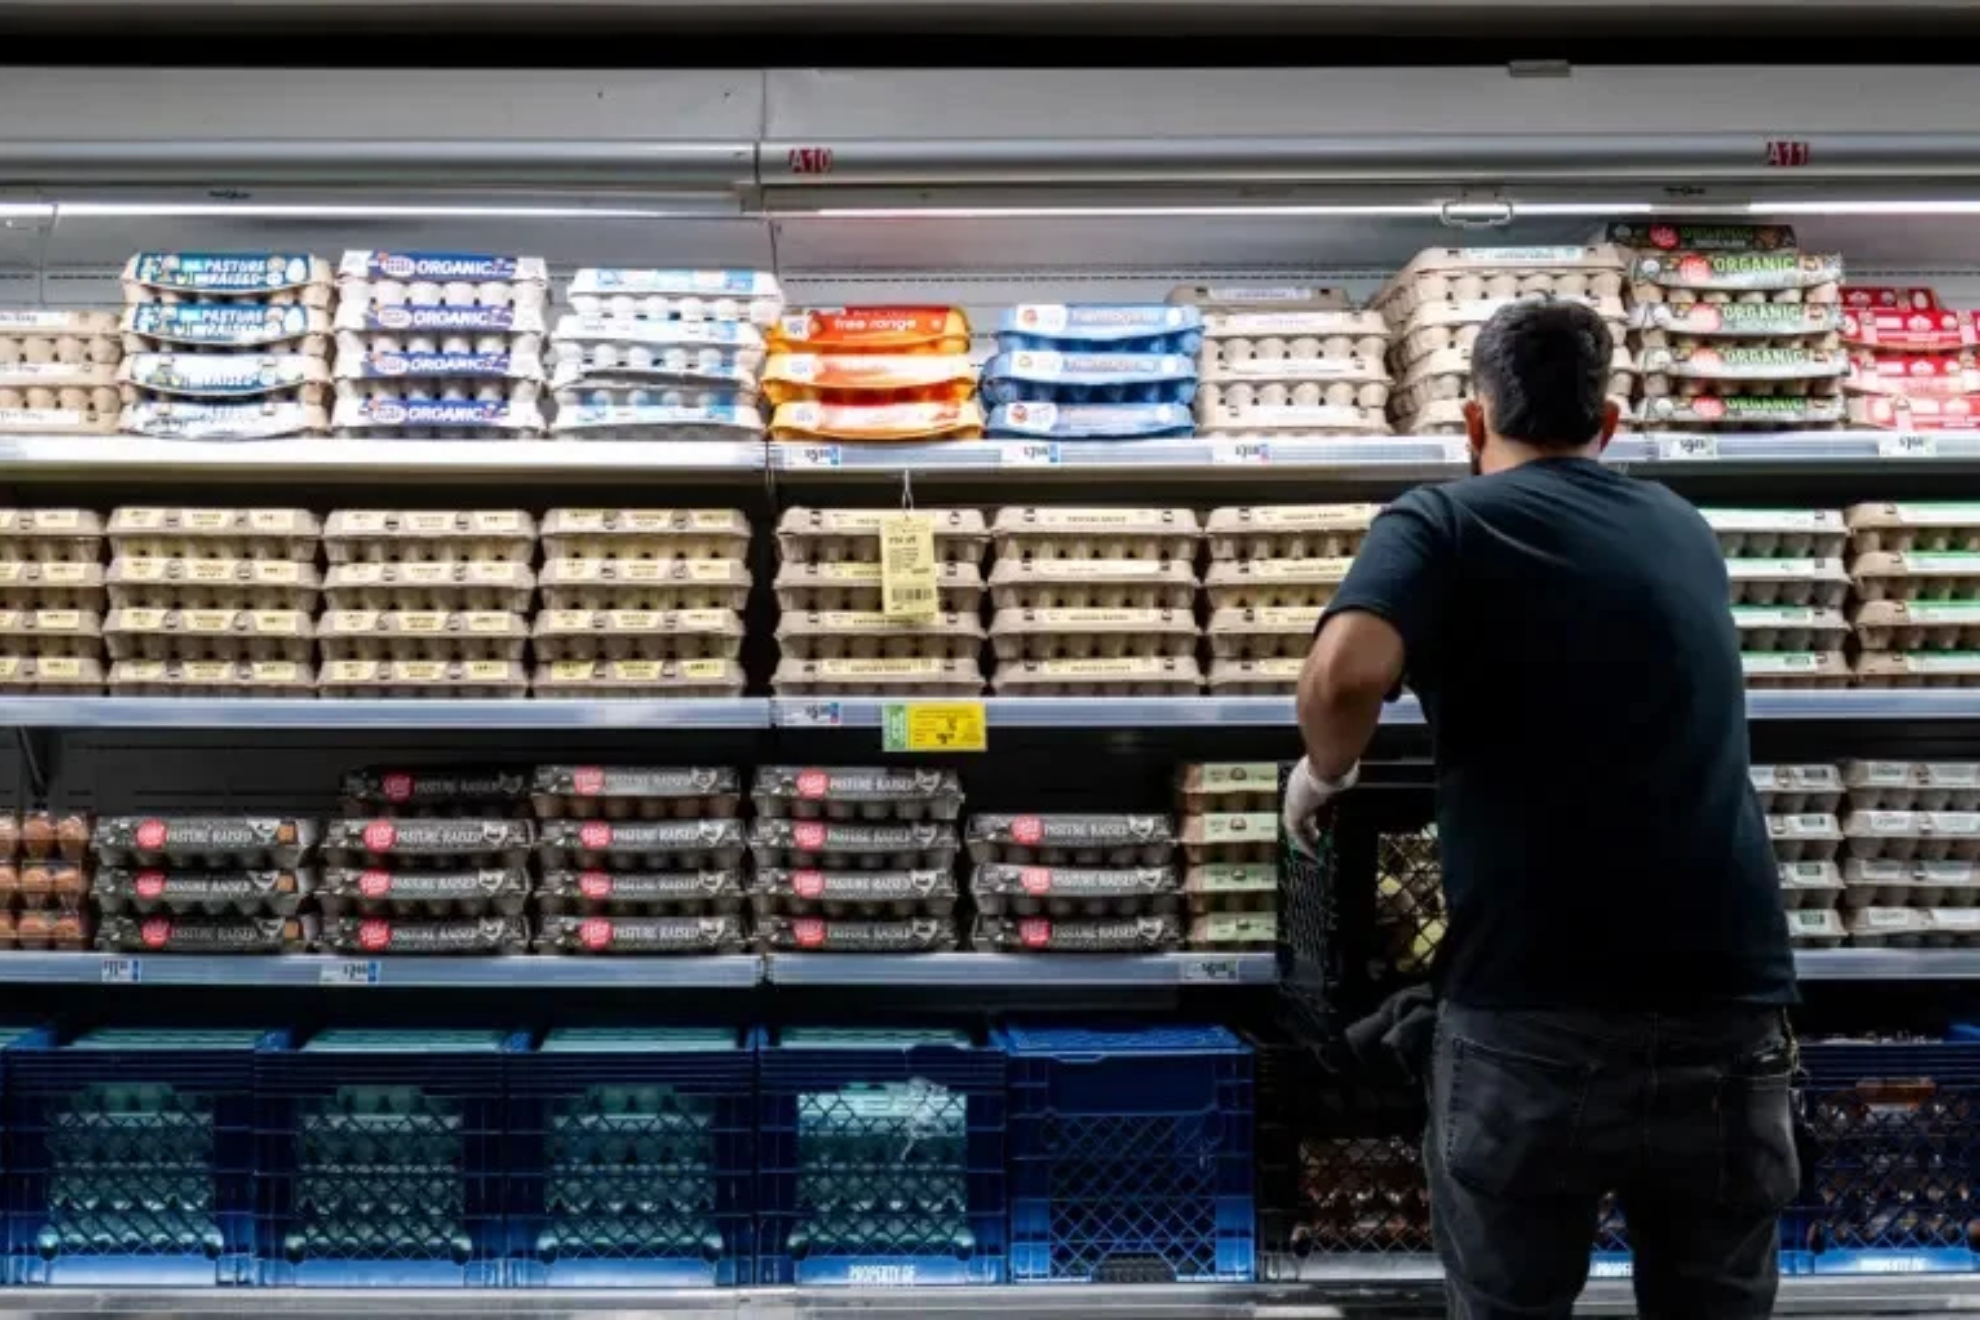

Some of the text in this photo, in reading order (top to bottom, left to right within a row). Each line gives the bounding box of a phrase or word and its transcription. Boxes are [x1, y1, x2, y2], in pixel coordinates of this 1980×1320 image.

[416, 259, 493, 275] ORGANIC
[1713, 256, 1796, 273] ORGANIC
[412, 308, 488, 326] ORGANIC
[1722, 304, 1802, 321] ORGANIC
[834, 317, 916, 333] free range
[410, 357, 487, 371] ORGANIC
[1724, 348, 1805, 365] ORGANIC
[408, 406, 485, 421] ORGANIC
